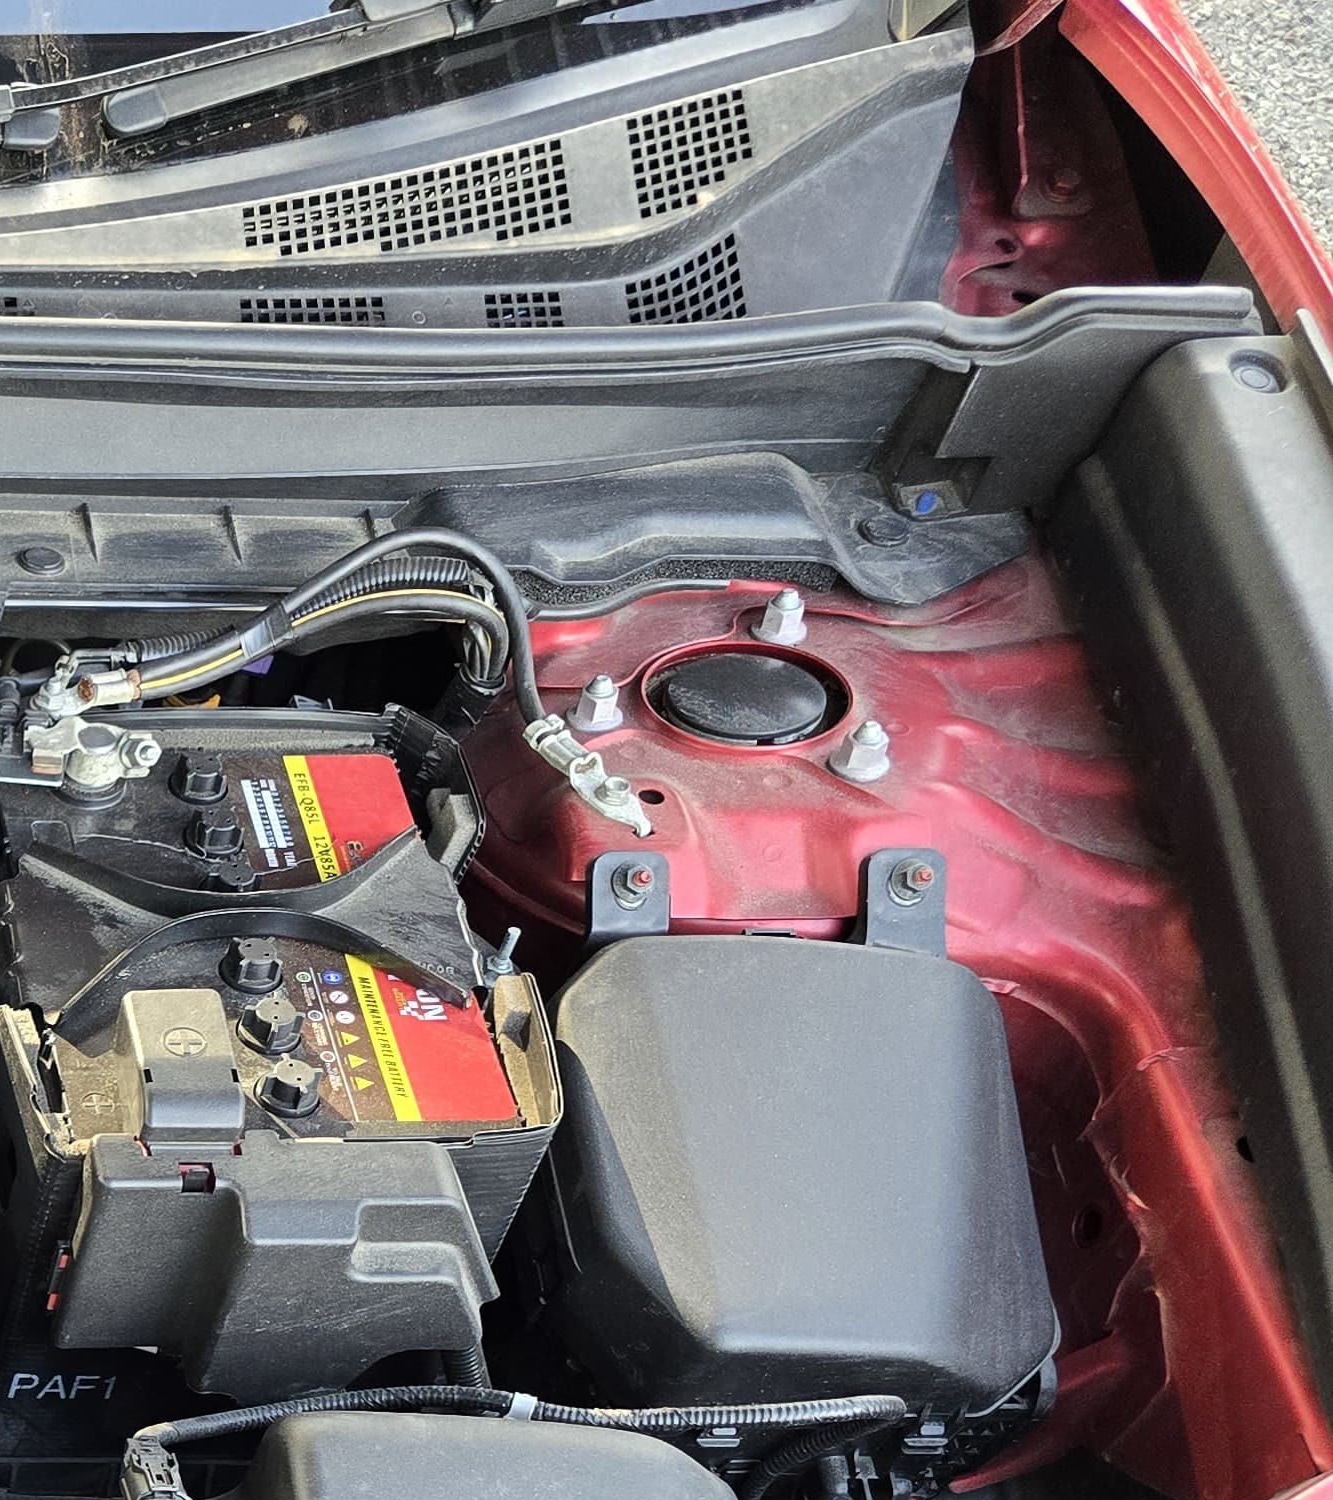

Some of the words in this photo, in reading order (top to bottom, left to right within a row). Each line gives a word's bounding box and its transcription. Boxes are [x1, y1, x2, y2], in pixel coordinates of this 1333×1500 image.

[293, 772, 319, 825] EFB-Q85L
[358, 976, 387, 1037] MAINTENANCE
[378, 1038, 394, 1059] FREE
[385, 1059, 408, 1098] BATTERY
[7, 1372, 117, 1400] PAF1
